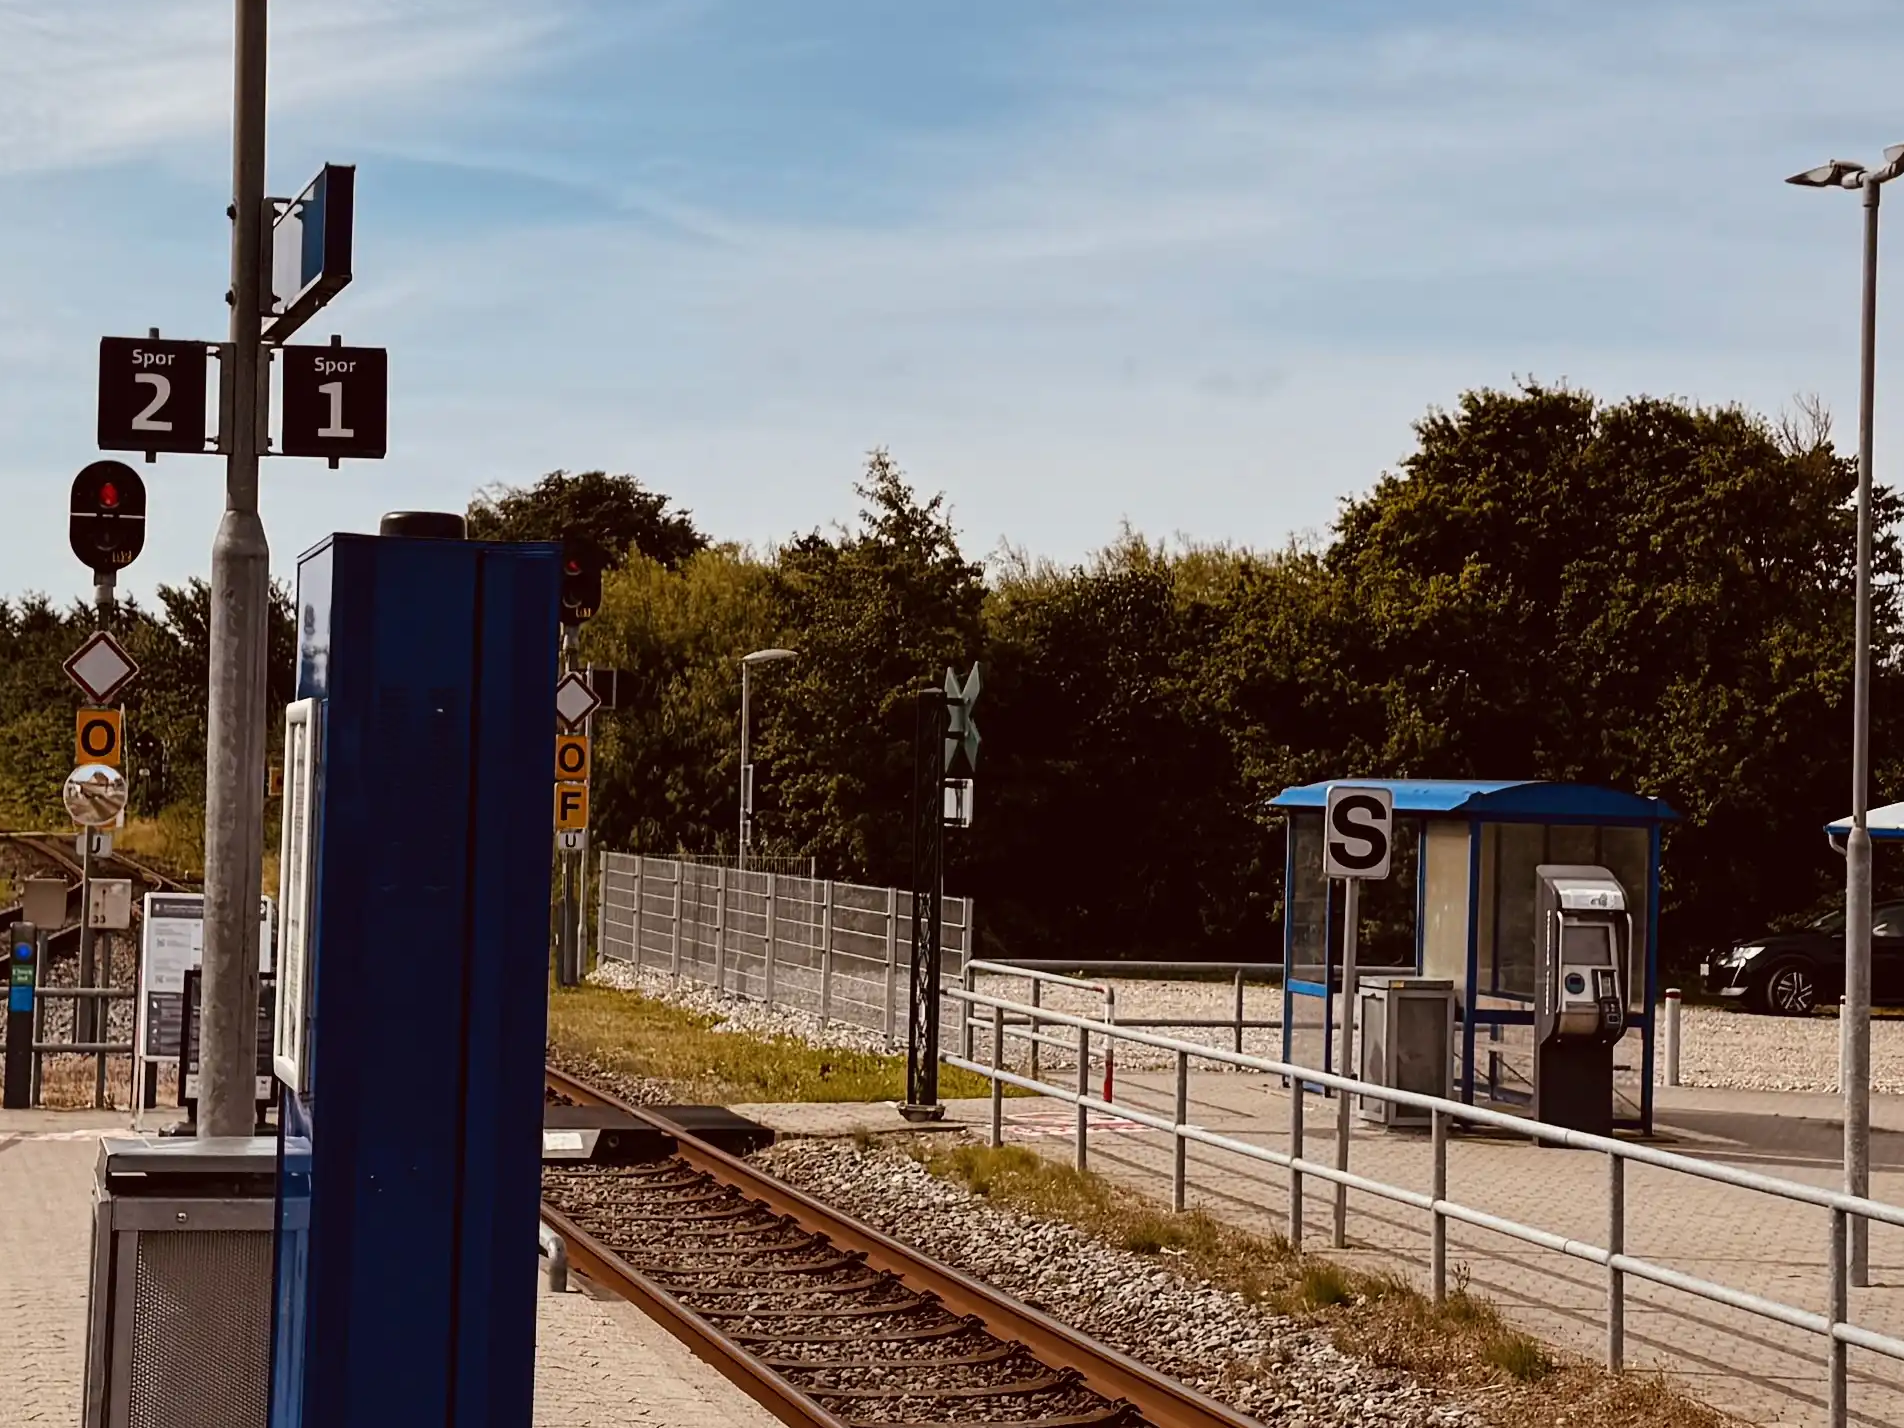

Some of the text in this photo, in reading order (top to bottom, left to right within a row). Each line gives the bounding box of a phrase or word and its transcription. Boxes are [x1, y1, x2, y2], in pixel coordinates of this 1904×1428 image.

[132, 348, 176, 368] Spor
[314, 356, 357, 376] Spor
[131, 372, 173, 432] 2
[317, 381, 355, 438] 1
[80, 719, 116, 757] O
[558, 742, 585, 773] O
[560, 791, 582, 821] F
[565, 834, 577, 848] U
[1328, 795, 1388, 870] S
